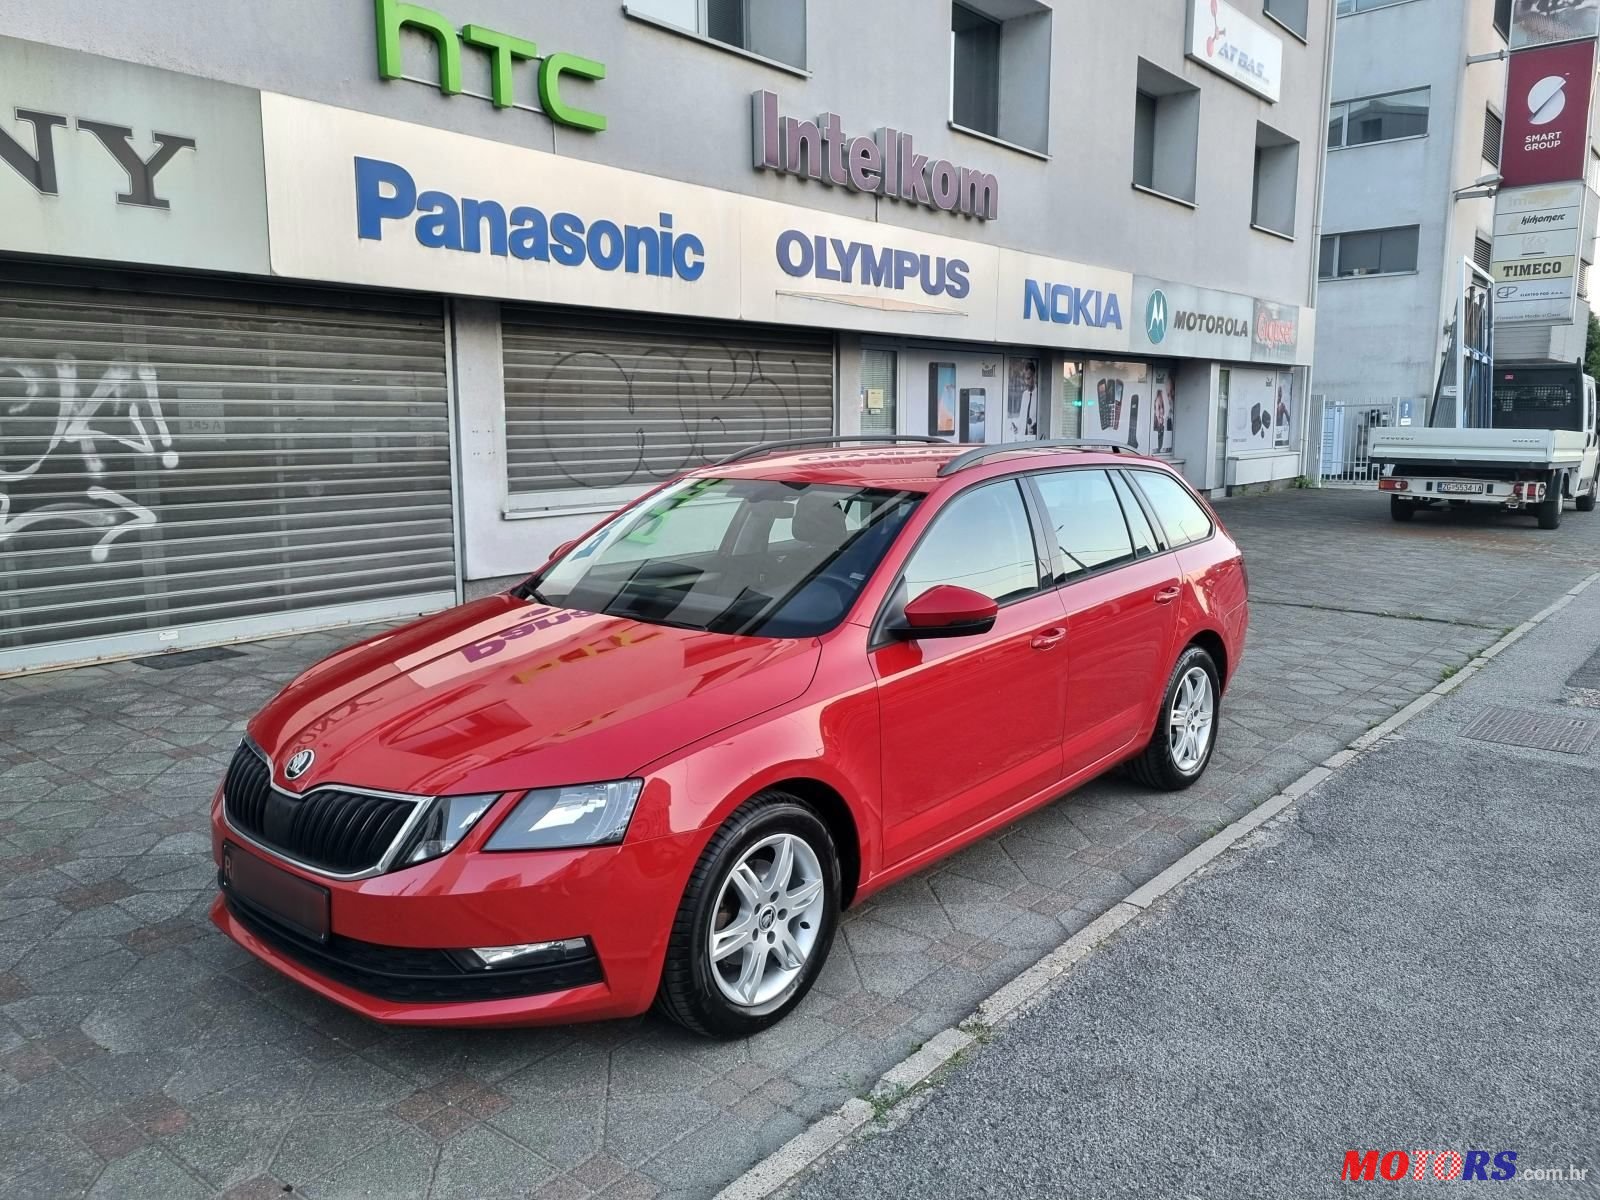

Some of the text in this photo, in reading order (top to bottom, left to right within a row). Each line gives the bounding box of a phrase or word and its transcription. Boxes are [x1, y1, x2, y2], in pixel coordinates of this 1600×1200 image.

[752, 88, 999, 221] Intelkom
[1524, 140, 1561, 151] GROUP
[1525, 131, 1562, 143] SMART
[354, 156, 705, 281] Panasonic
[776, 229, 970, 299] OLYMPUS
[1503, 262, 1562, 277] TIMECO
[1023, 278, 1122, 330] NOKIA
[1174, 310, 1248, 337] MOTOROLA
